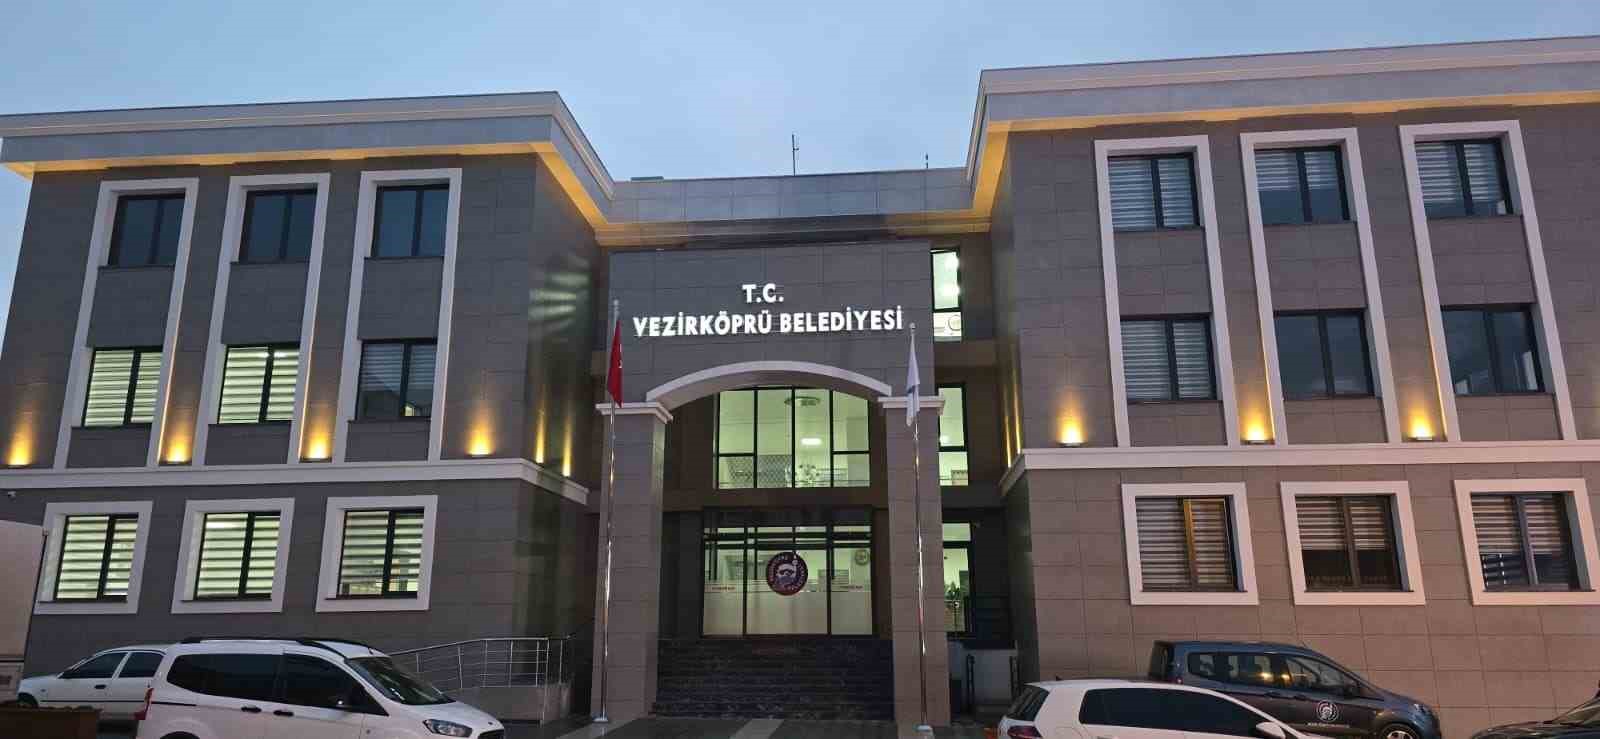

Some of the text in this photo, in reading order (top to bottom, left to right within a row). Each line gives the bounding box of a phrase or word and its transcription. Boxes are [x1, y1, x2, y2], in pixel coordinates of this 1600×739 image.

[742, 283, 784, 303] T.C.
[633, 306, 903, 337] VEZİRKÖPRÜ BELEDİYESİ
